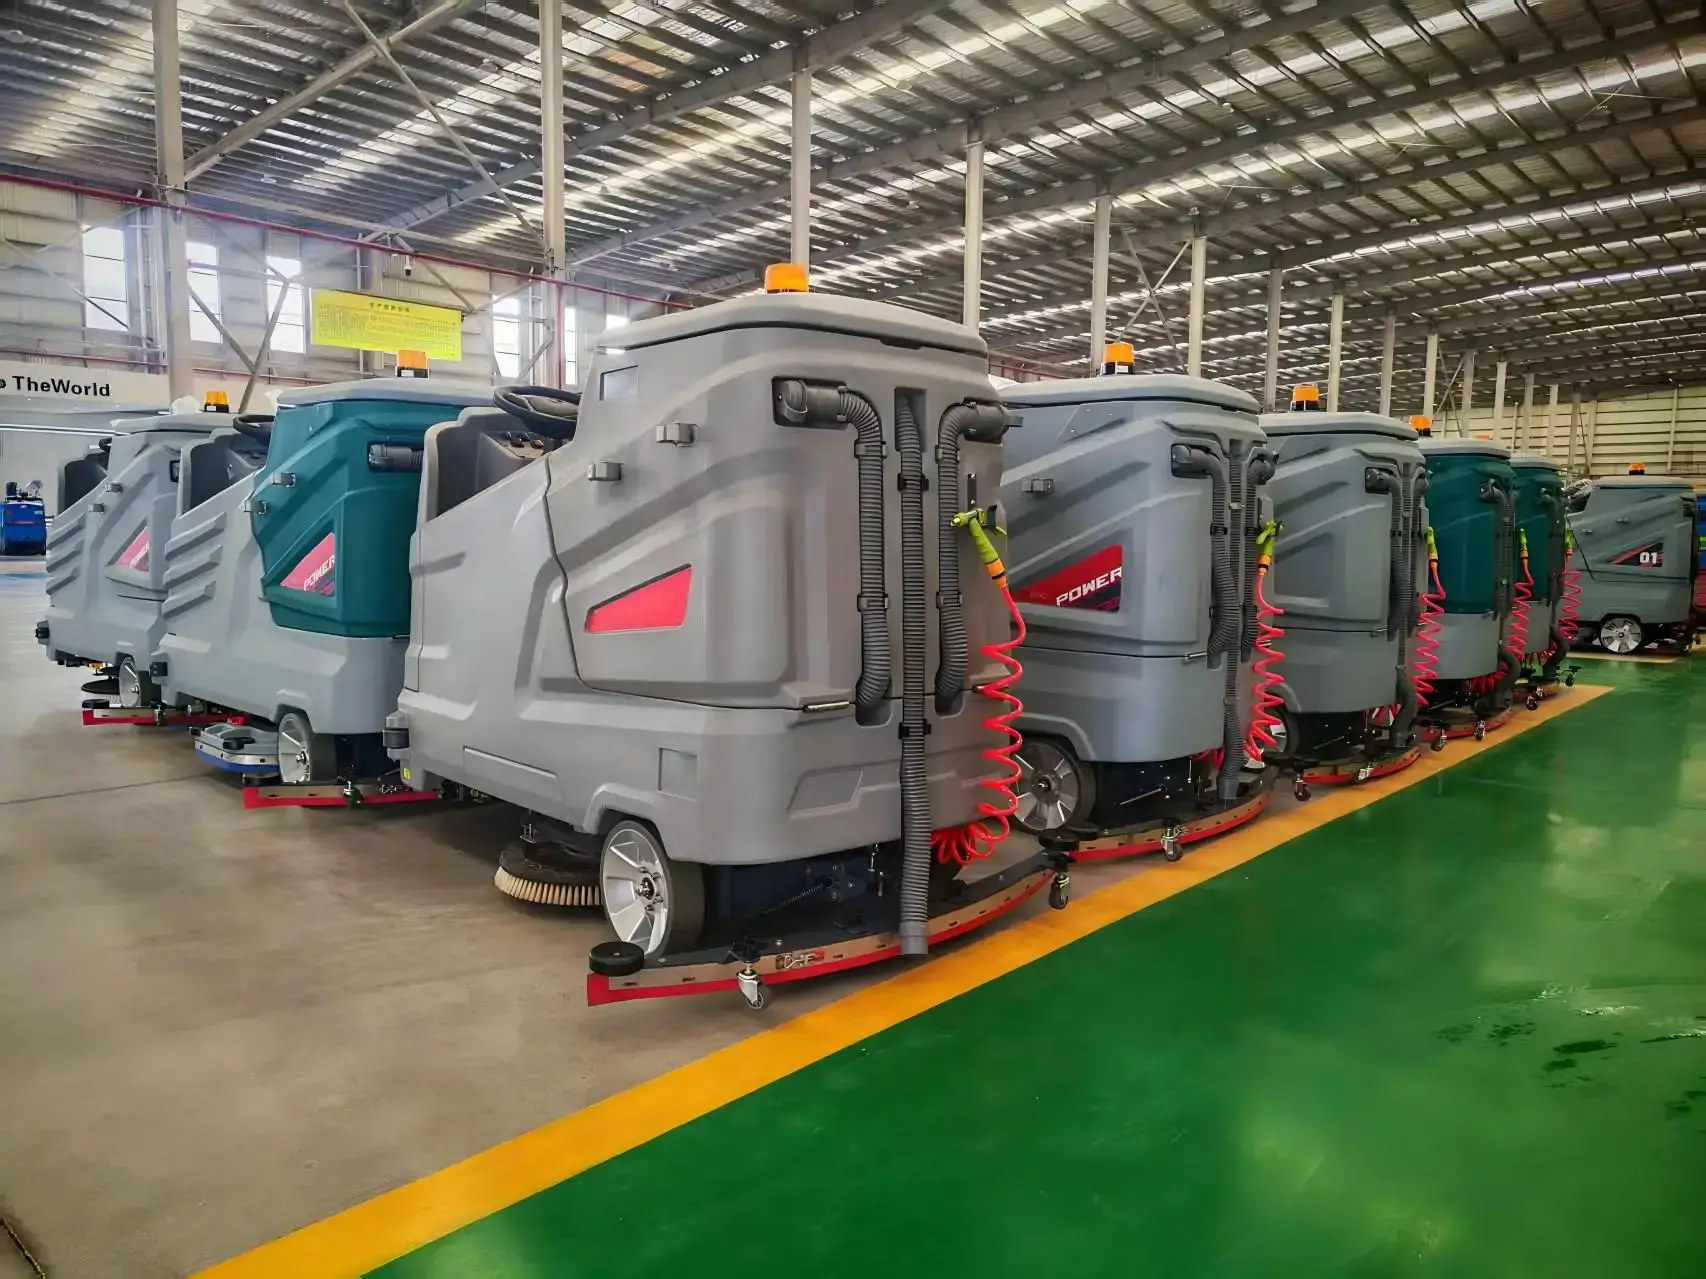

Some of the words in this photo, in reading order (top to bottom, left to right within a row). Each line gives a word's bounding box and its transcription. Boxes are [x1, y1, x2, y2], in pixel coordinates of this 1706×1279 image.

[12, 375, 110, 396] TheWorld
[1639, 551, 1658, 564] 01
[1056, 566, 1122, 607] POWER
